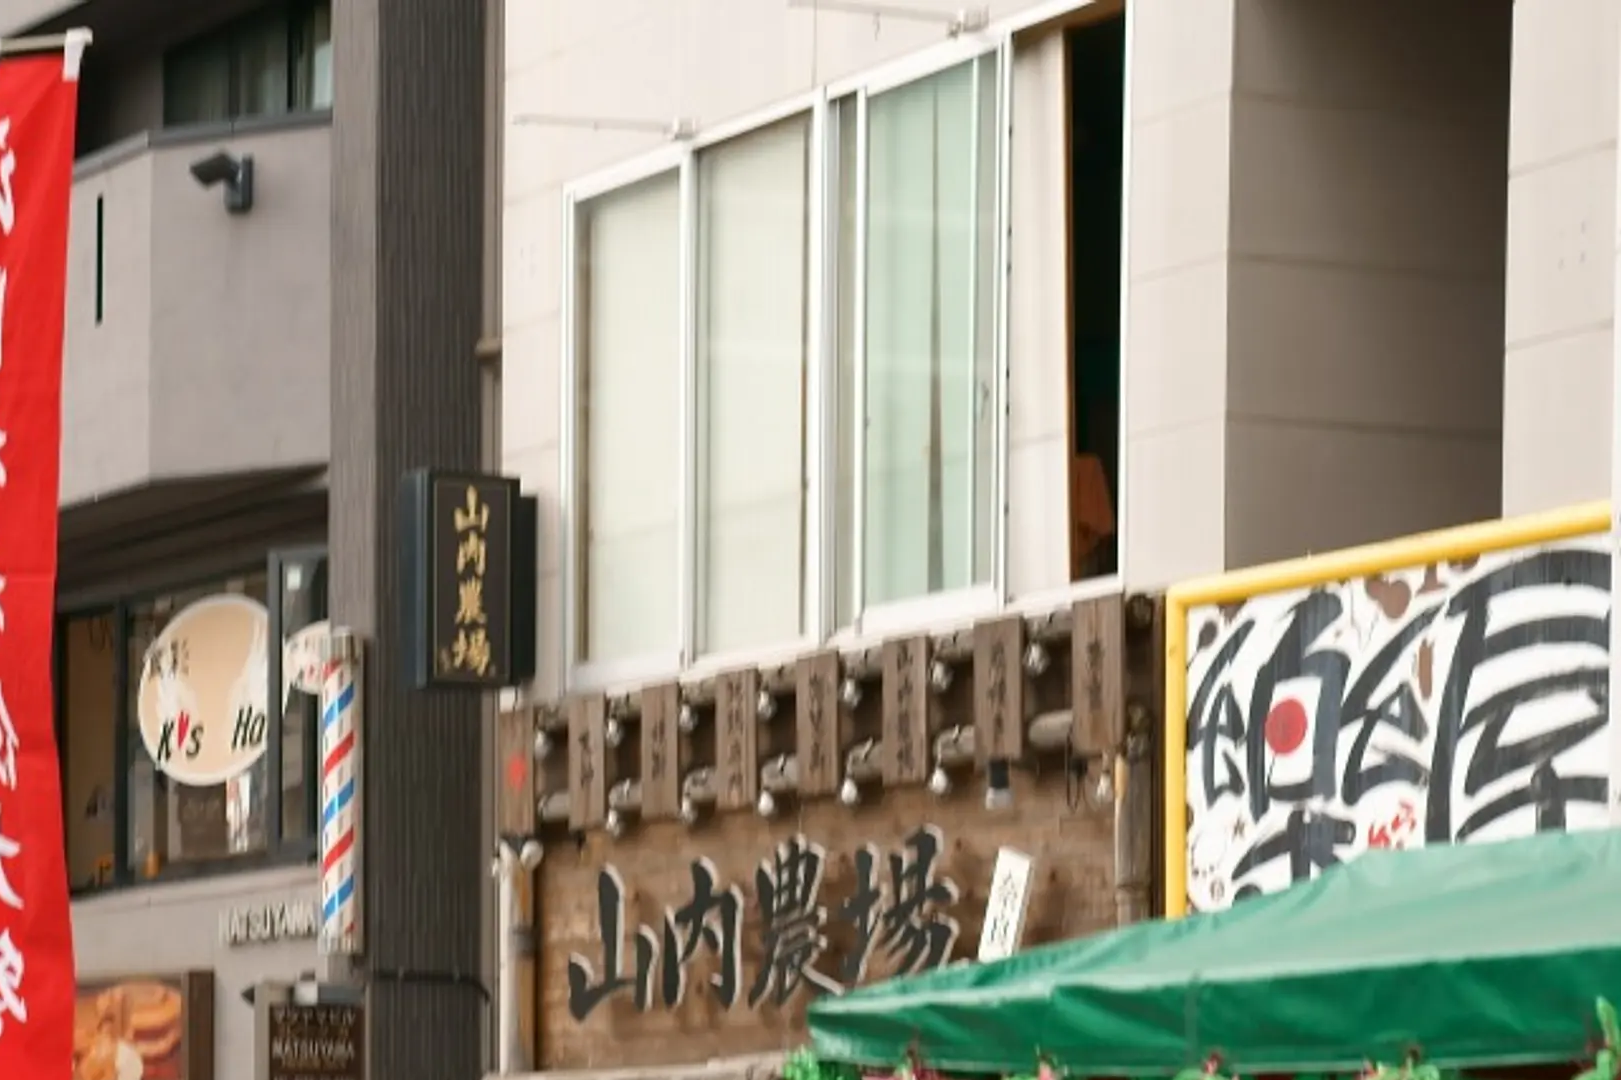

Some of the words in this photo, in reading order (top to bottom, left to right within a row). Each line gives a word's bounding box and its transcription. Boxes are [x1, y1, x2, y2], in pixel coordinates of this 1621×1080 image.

[230, 703, 267, 751] Ha
[568, 824, 960, 1022] 山内農場
